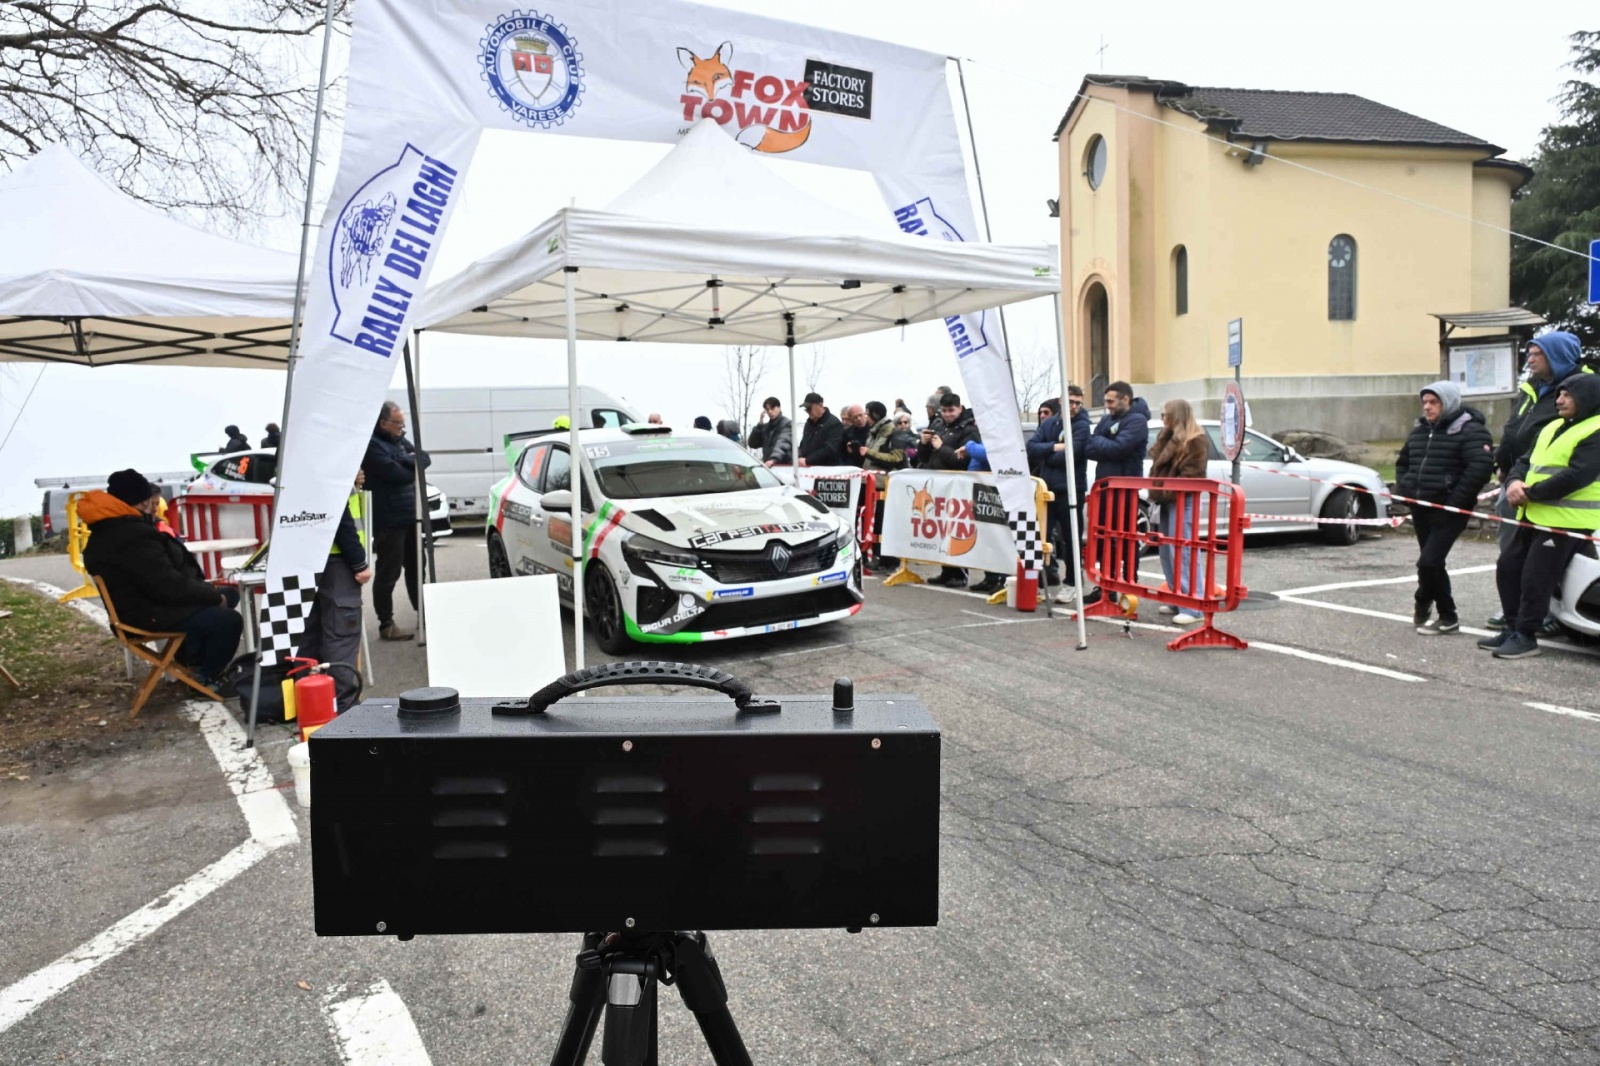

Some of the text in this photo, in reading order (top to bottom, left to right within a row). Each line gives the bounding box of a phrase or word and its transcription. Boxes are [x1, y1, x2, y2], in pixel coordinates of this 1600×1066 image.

[486, 19, 578, 85] AUTOMOBILE CLUB
[730, 70, 811, 109] FOX
[813, 70, 866, 93] FACTORY
[812, 87, 864, 109] STORES
[511, 100, 564, 120] VARESE
[680, 94, 808, 131] TOWN
[354, 155, 458, 358] RALLY DEI LAGHI
[588, 446, 608, 458] 15
[817, 481, 847, 492] FACTORY
[818, 492, 847, 502] STORES
[279, 510, 327, 524] PubliStar
[935, 497, 976, 520] FOX
[910, 517, 976, 539] TOWN
[641, 606, 705, 633] SICUR DELTA
